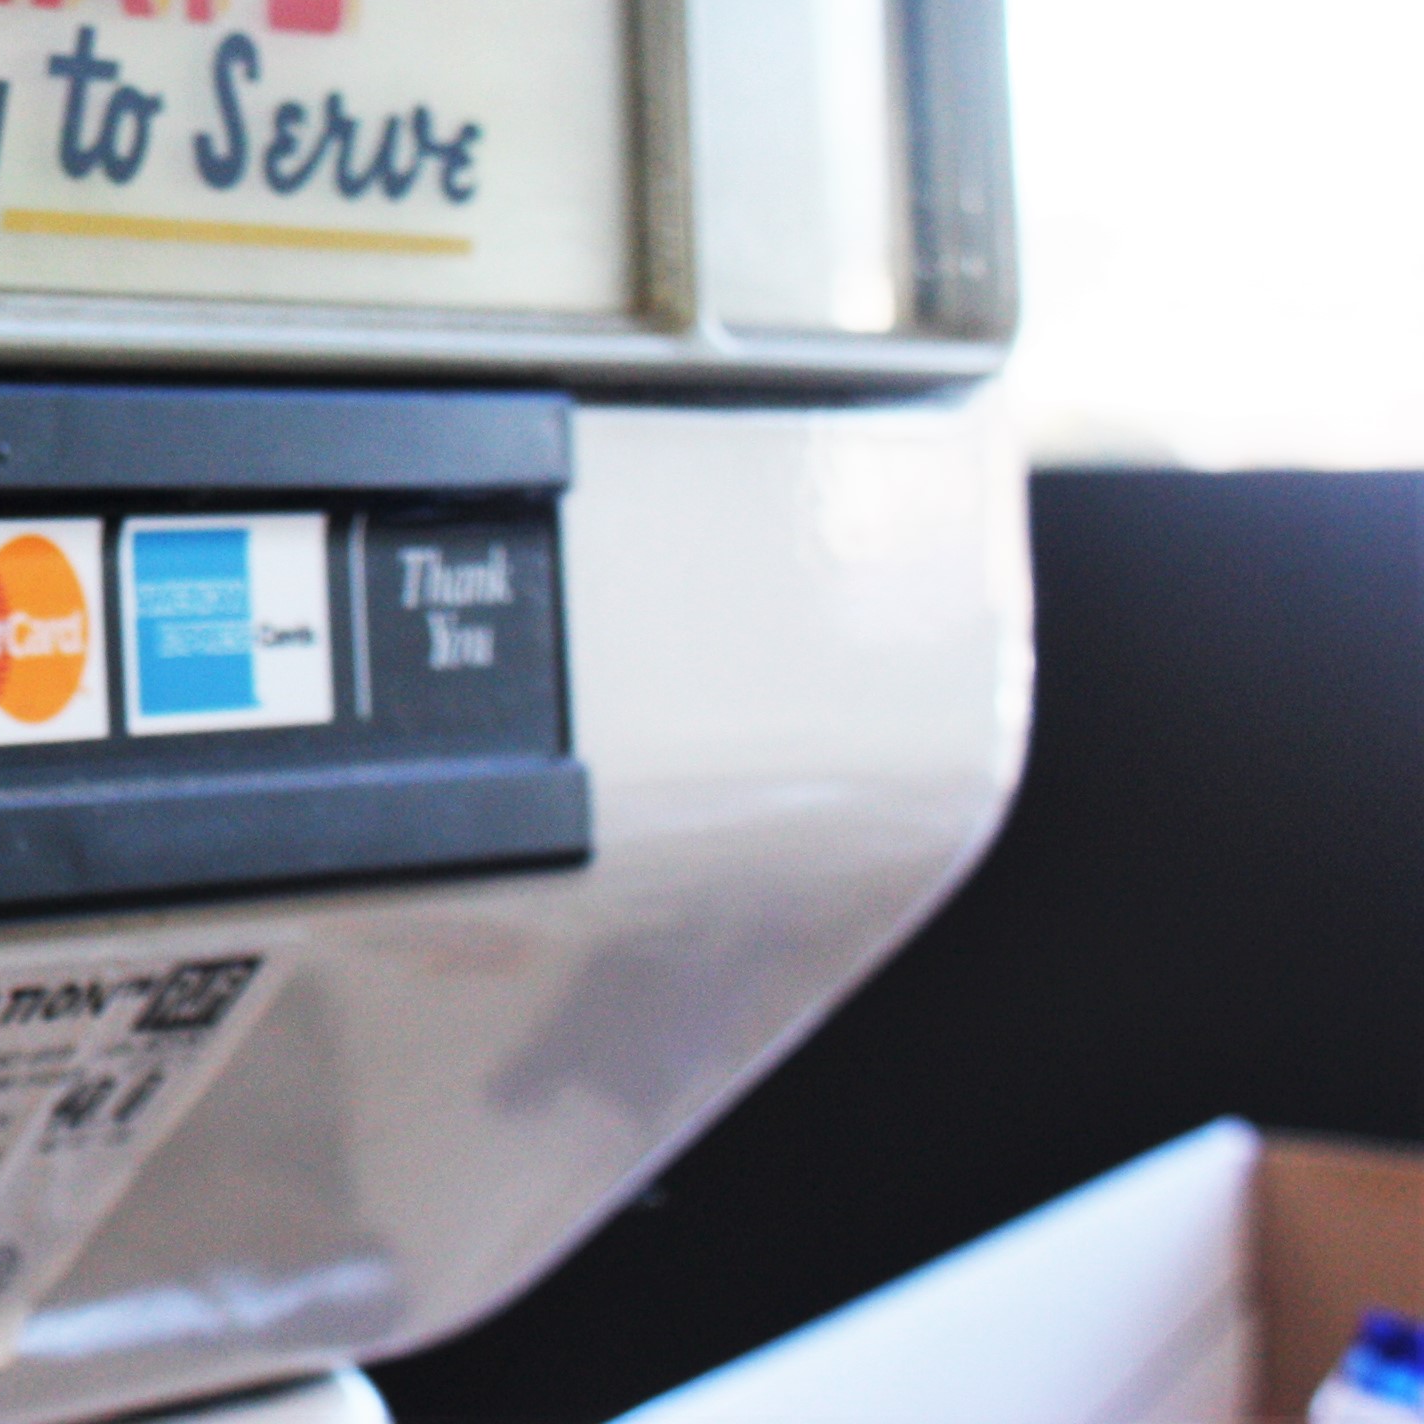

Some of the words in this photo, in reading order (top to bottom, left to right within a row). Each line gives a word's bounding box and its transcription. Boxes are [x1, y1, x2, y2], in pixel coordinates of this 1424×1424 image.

[47, 25, 164, 186] to
[192, 33, 483, 206] Serve
[396, 542, 512, 611] Thank
